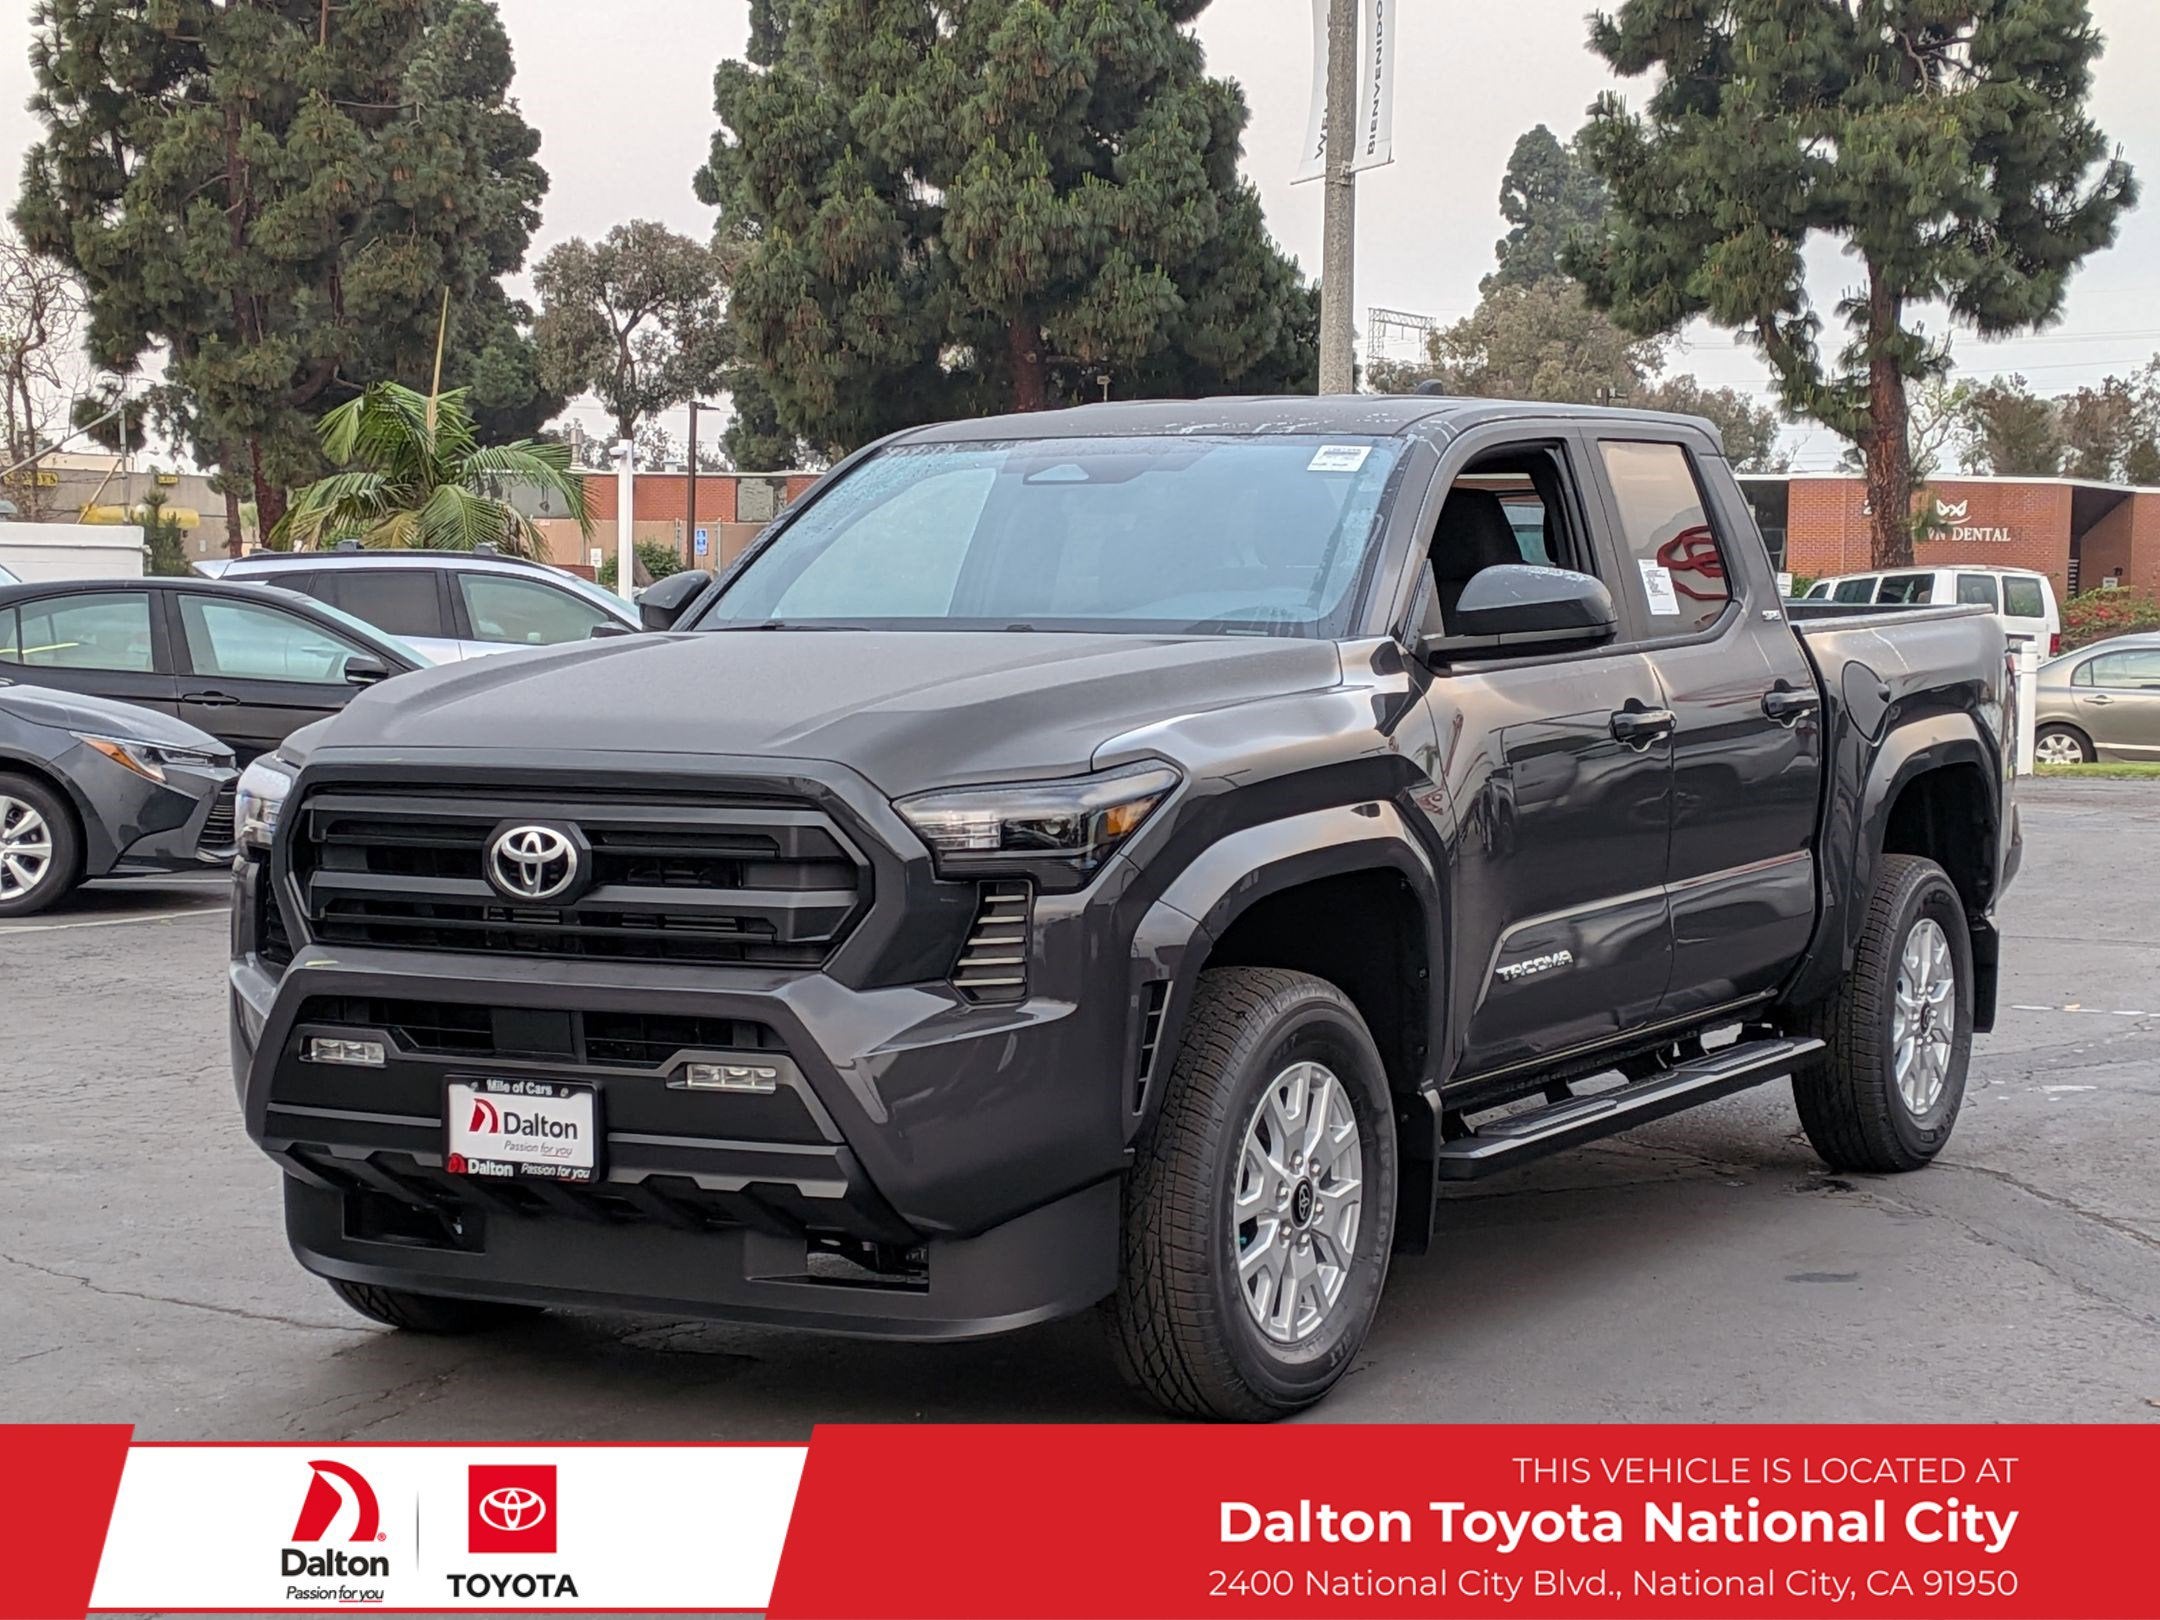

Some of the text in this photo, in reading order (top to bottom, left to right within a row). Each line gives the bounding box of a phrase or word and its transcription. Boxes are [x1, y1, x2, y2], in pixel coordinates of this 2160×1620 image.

[1952, 527, 2011, 542] DENTAL
[1495, 950, 1574, 981] TACOMA
[486, 1079, 552, 1096] Mile of Cars
[503, 1112, 578, 1140] Dalton
[504, 1140, 573, 1157] Passion for you
[468, 1158, 591, 1180] Dalton Passion for you
